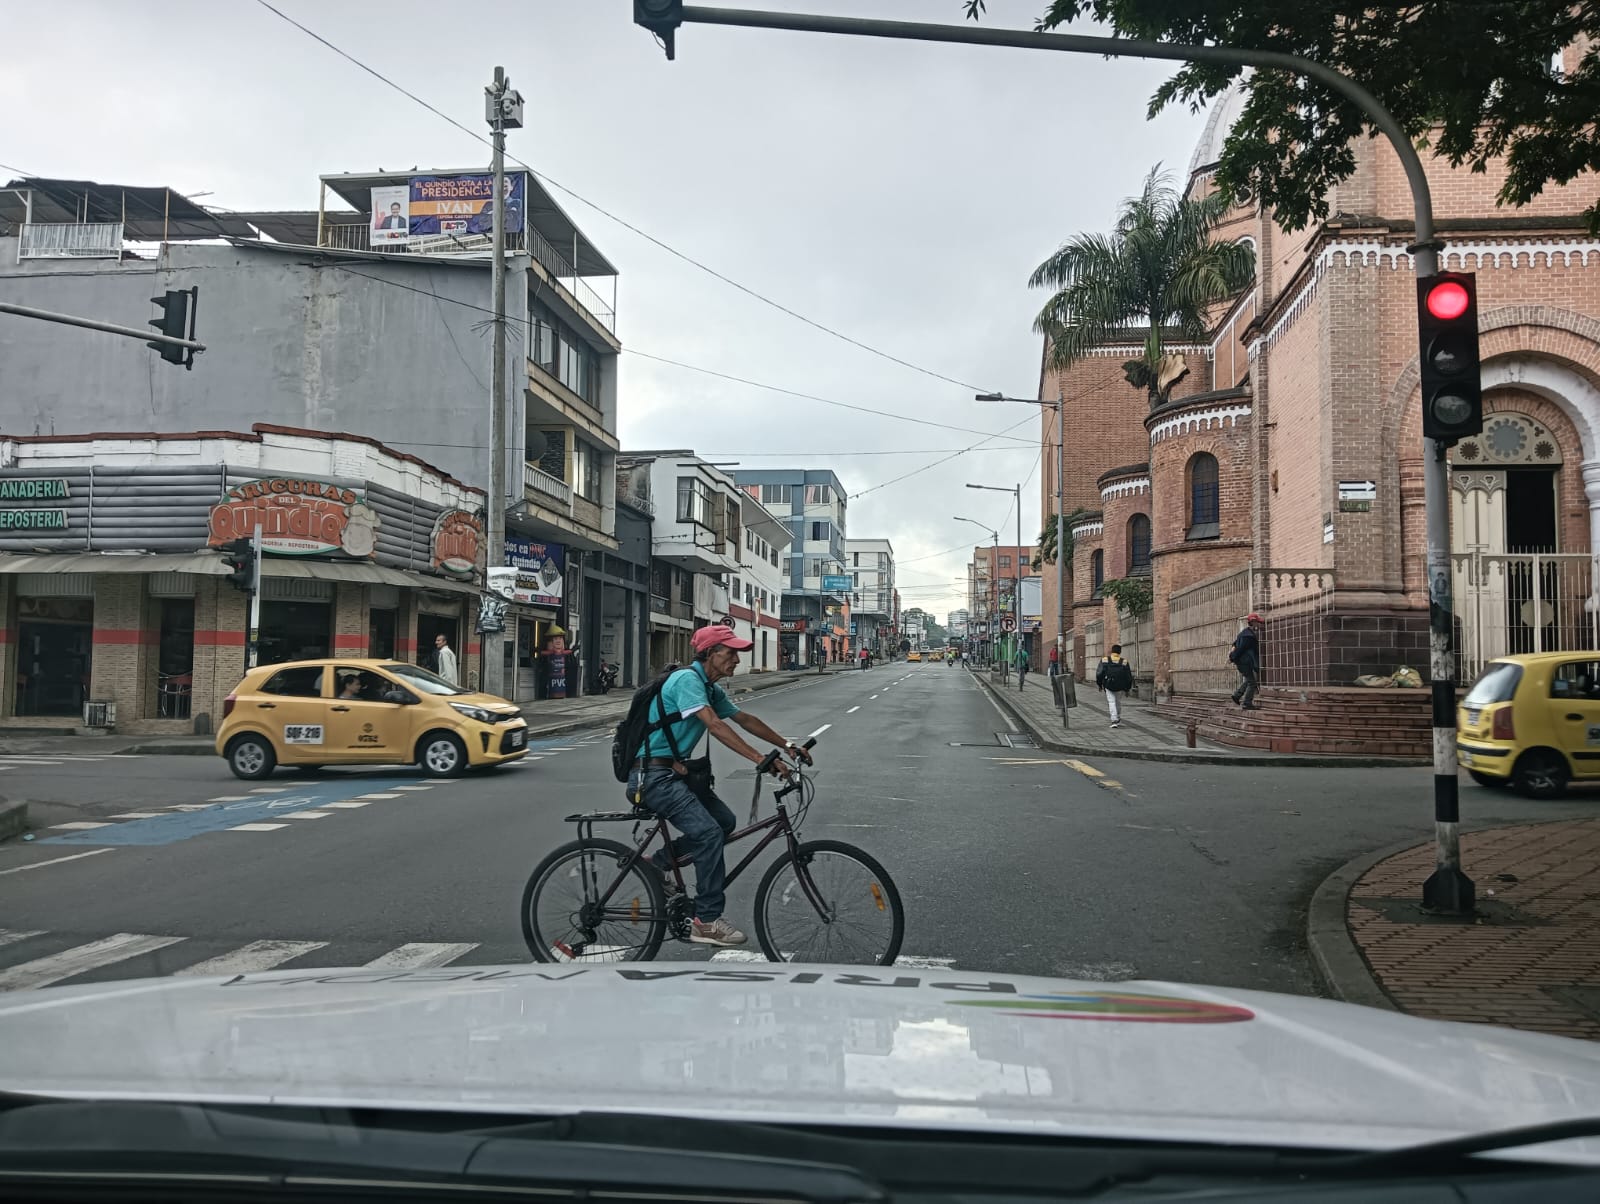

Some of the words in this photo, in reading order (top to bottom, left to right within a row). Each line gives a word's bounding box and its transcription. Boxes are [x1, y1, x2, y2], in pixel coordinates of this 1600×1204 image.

[415, 181, 422, 189] EL
[421, 186, 492, 197] PRESIDENCIA
[0, 480, 66, 498] ANADERIA
[231, 479, 357, 504] RICURAS
[279, 496, 296, 504] DEL
[0, 510, 64, 528] EPOSTERIA
[519, 544, 528, 554] en
[220, 970, 590, 986] MEDIA
[616, 969, 1018, 994] PRISA
